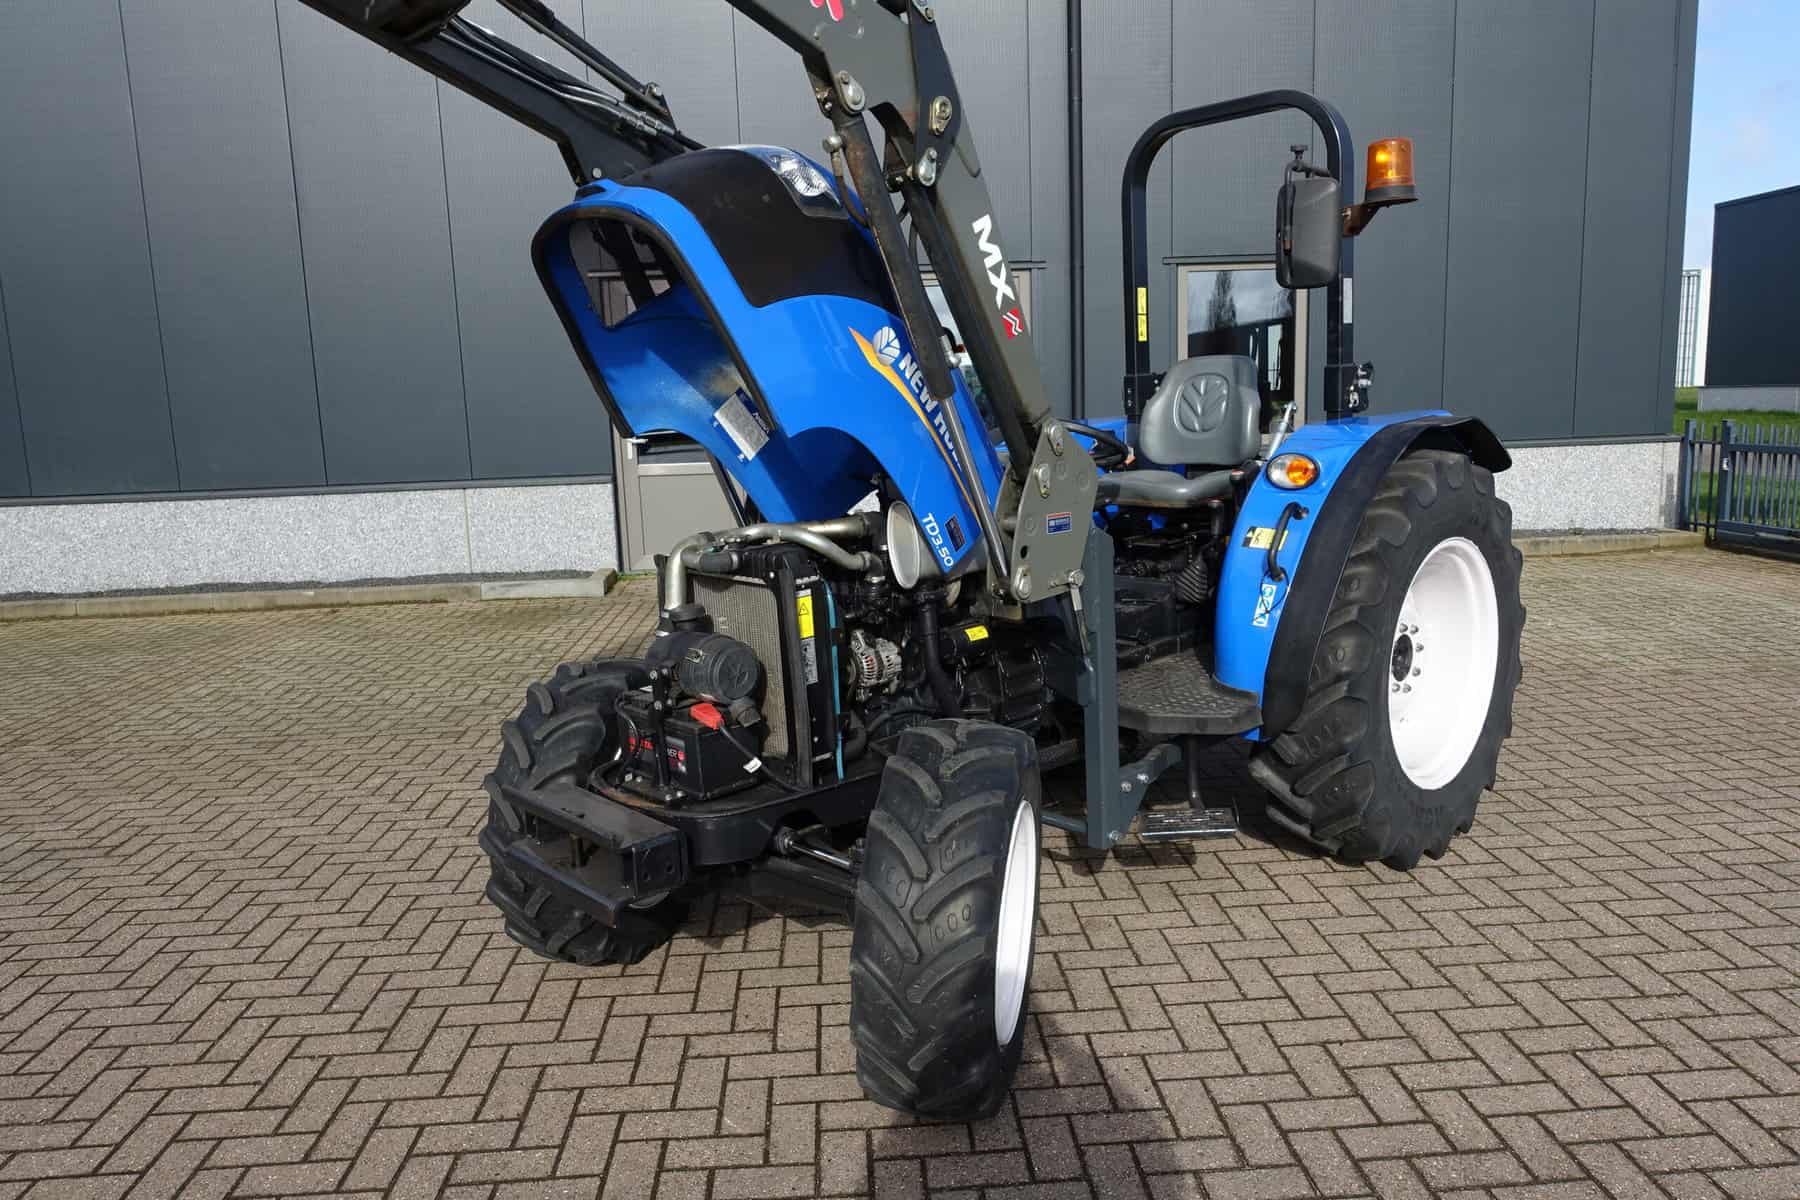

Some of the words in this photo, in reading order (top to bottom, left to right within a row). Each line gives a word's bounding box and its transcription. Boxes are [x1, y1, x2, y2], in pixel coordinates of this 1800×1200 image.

[972, 213, 1015, 310] MX
[898, 352, 938, 413] NEW
[922, 512, 954, 567] TD3.50
